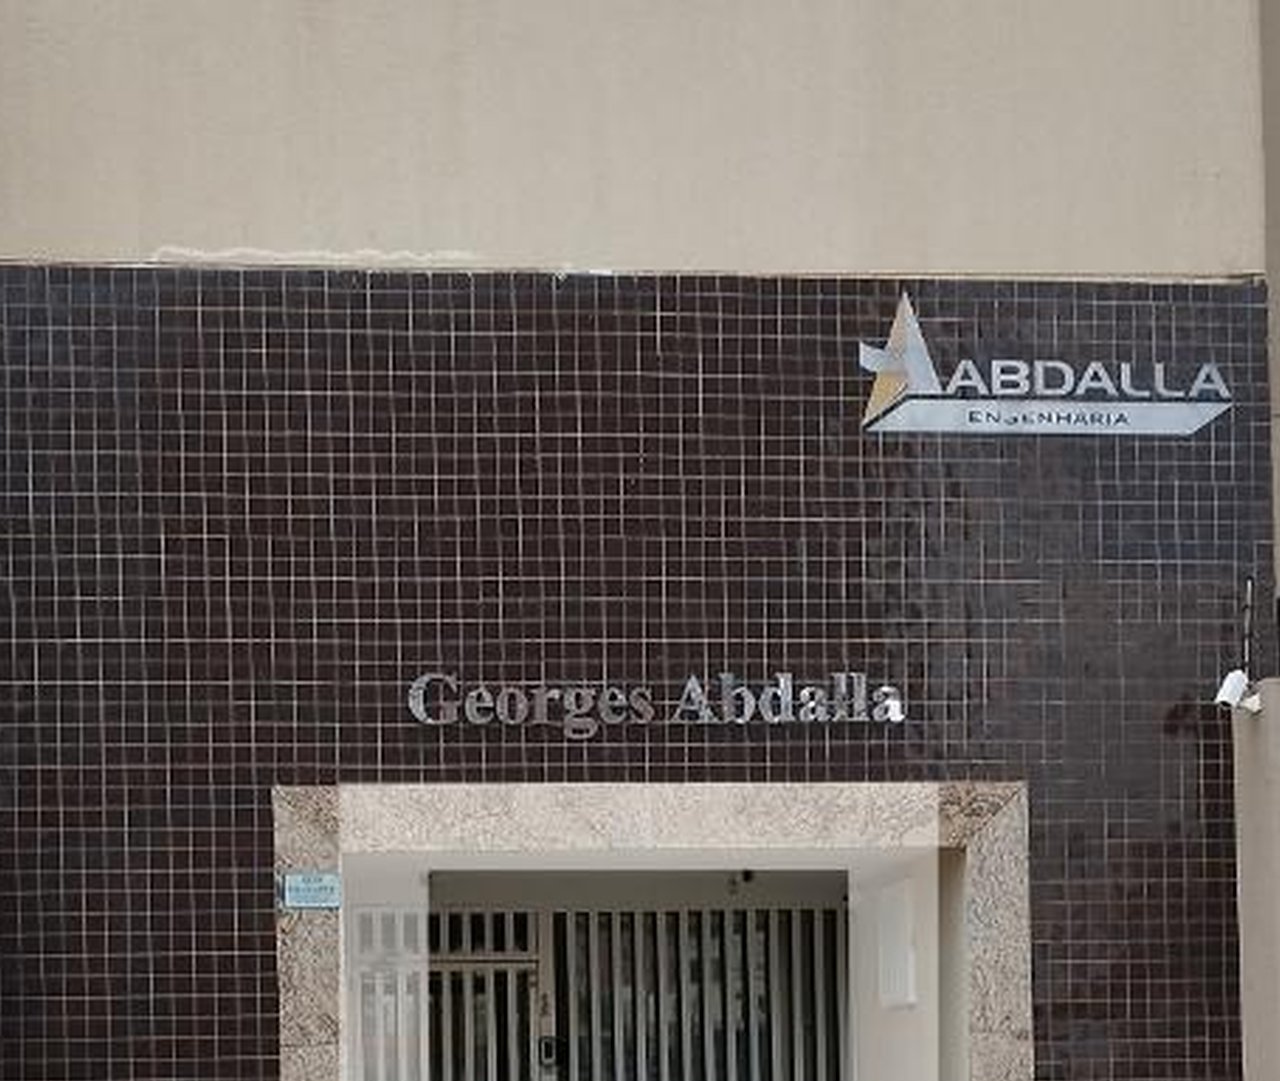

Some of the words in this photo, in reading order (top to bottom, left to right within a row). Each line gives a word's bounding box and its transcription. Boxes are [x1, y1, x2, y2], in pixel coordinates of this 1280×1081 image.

[946, 359, 1232, 398] ABDALLA
[408, 673, 656, 739] Georges
[673, 672, 906, 723] Abdalla
